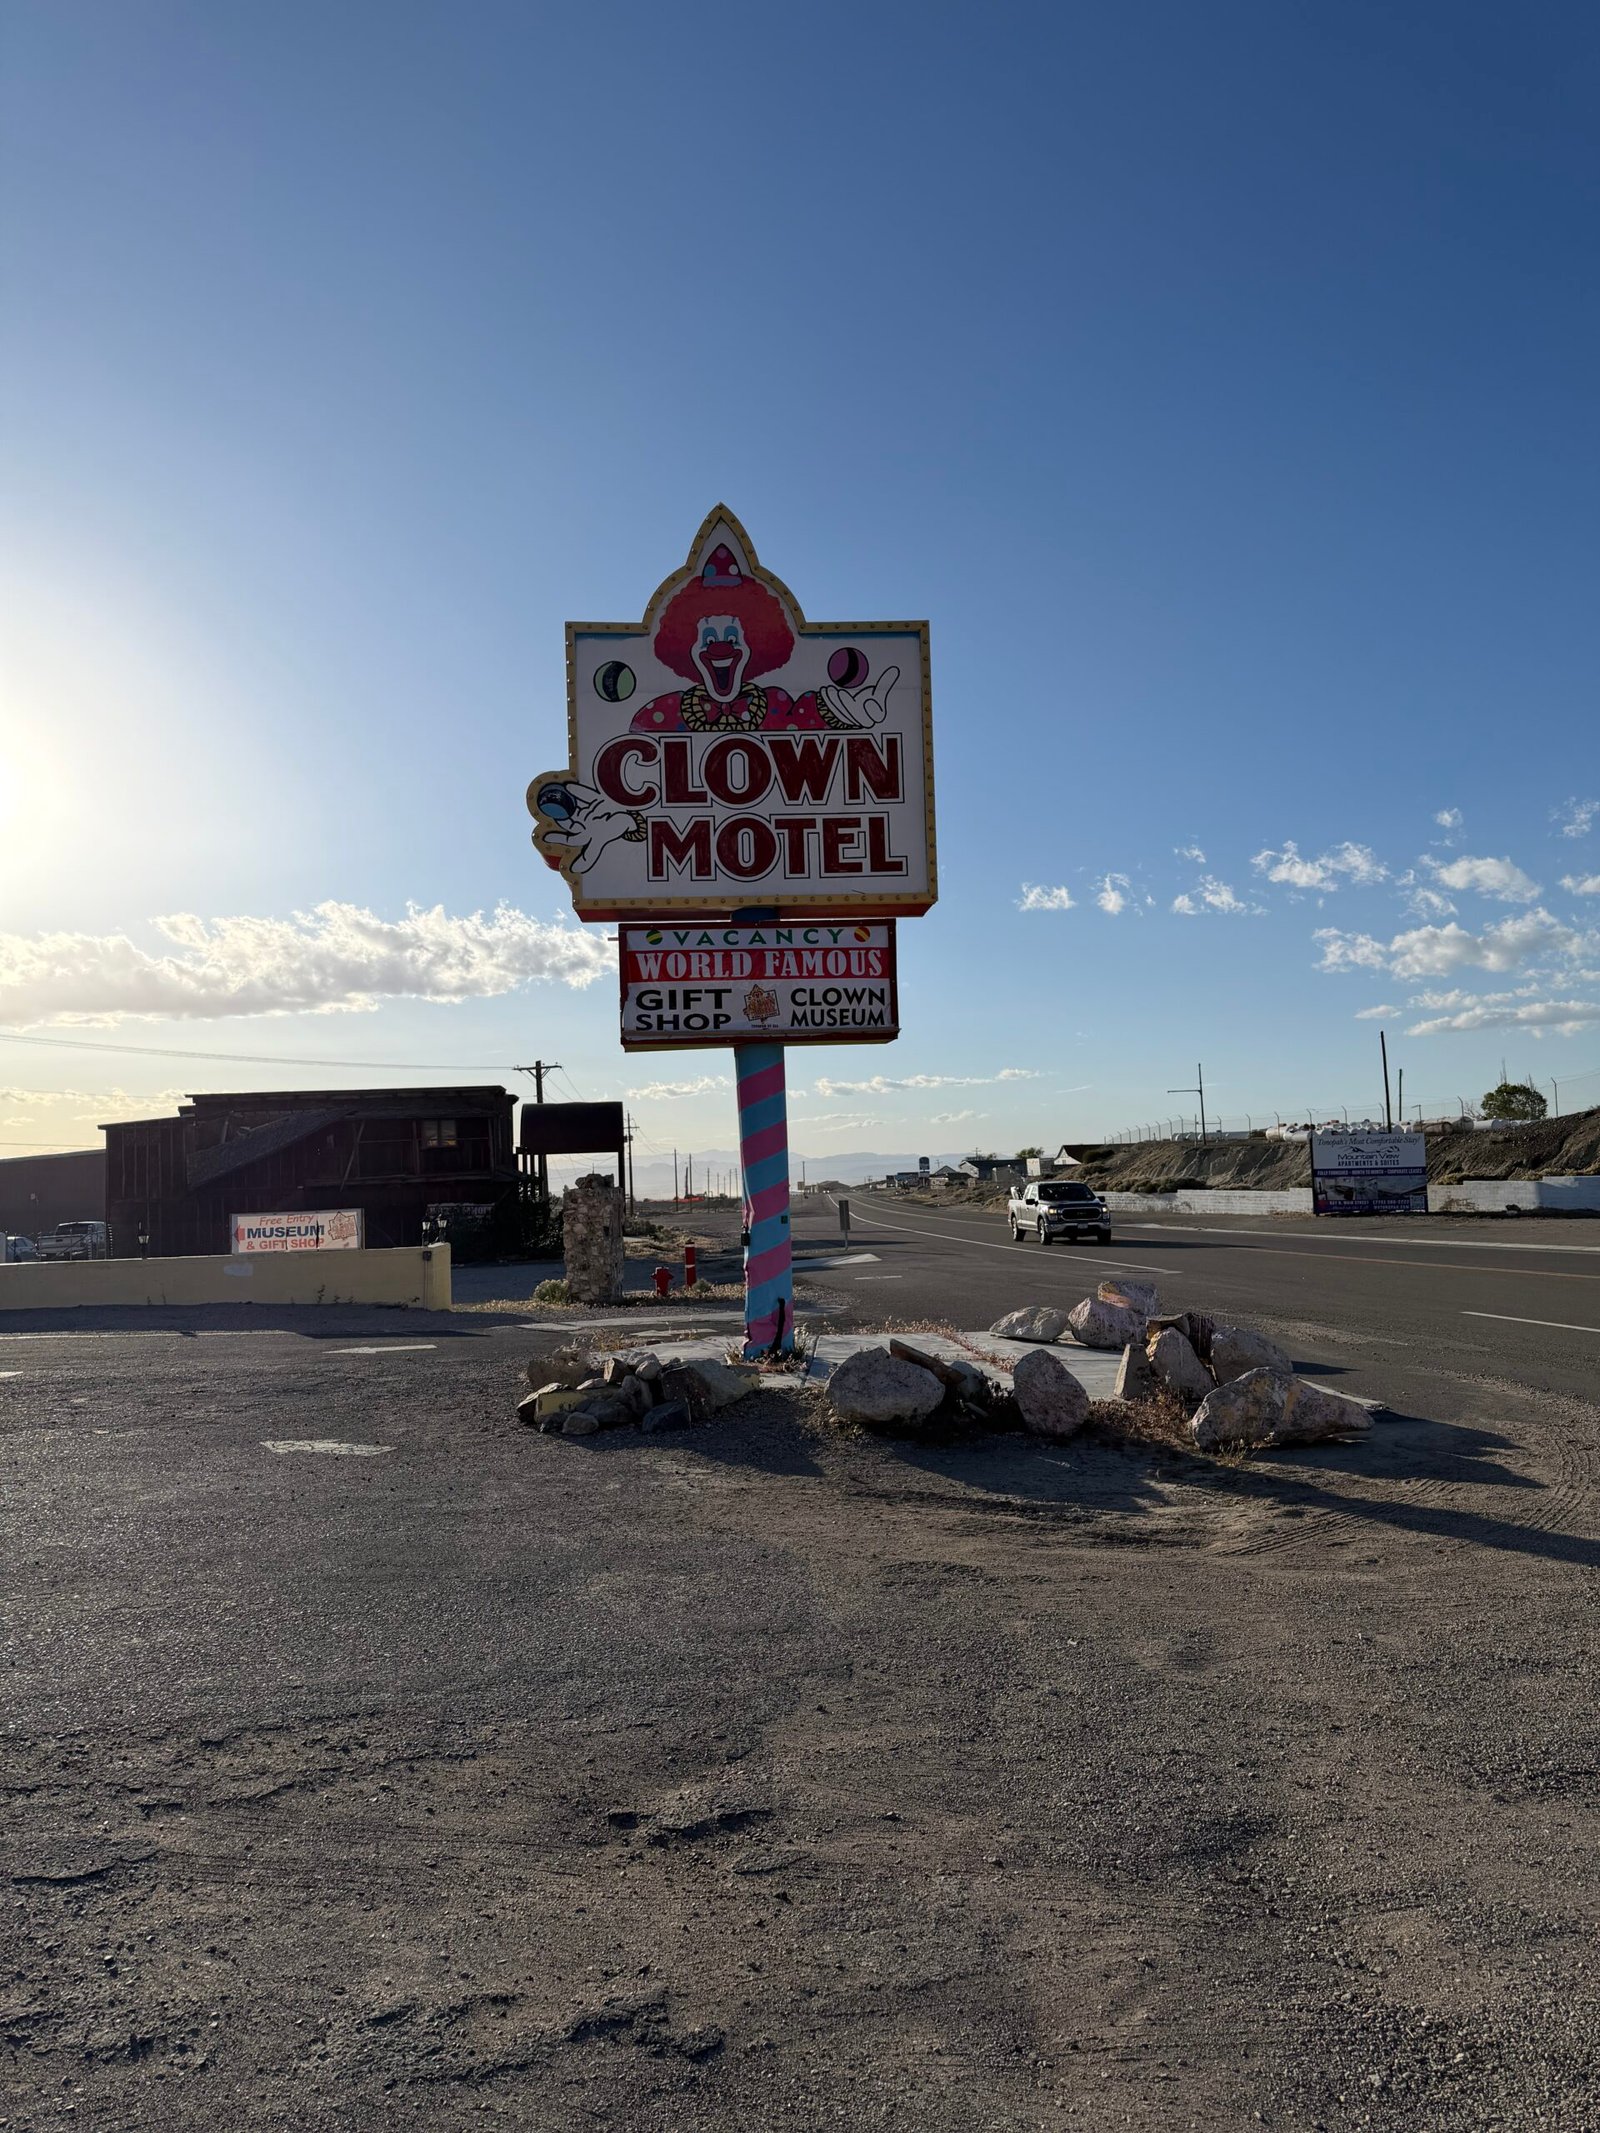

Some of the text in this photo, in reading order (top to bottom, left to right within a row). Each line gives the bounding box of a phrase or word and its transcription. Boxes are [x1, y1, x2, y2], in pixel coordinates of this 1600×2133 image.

[595, 735, 902, 808] CLOWN
[650, 814, 906, 880] MOTEL
[673, 928, 844, 946] VACANCY
[635, 950, 882, 980] WORLD FAMOUS
[635, 989, 732, 1011] GIFT
[790, 987, 885, 1007] CLOWN
[635, 1013, 732, 1031] SHOP
[790, 1008, 885, 1027] MUSEUM
[1349, 1136, 1365, 1145] Most
[1366, 1135, 1403, 1146] Comfortable
[260, 1214, 314, 1226] Free Entry
[247, 1225, 324, 1239] MUSEUM
[246, 1238, 324, 1250] & GIFT SHOP
